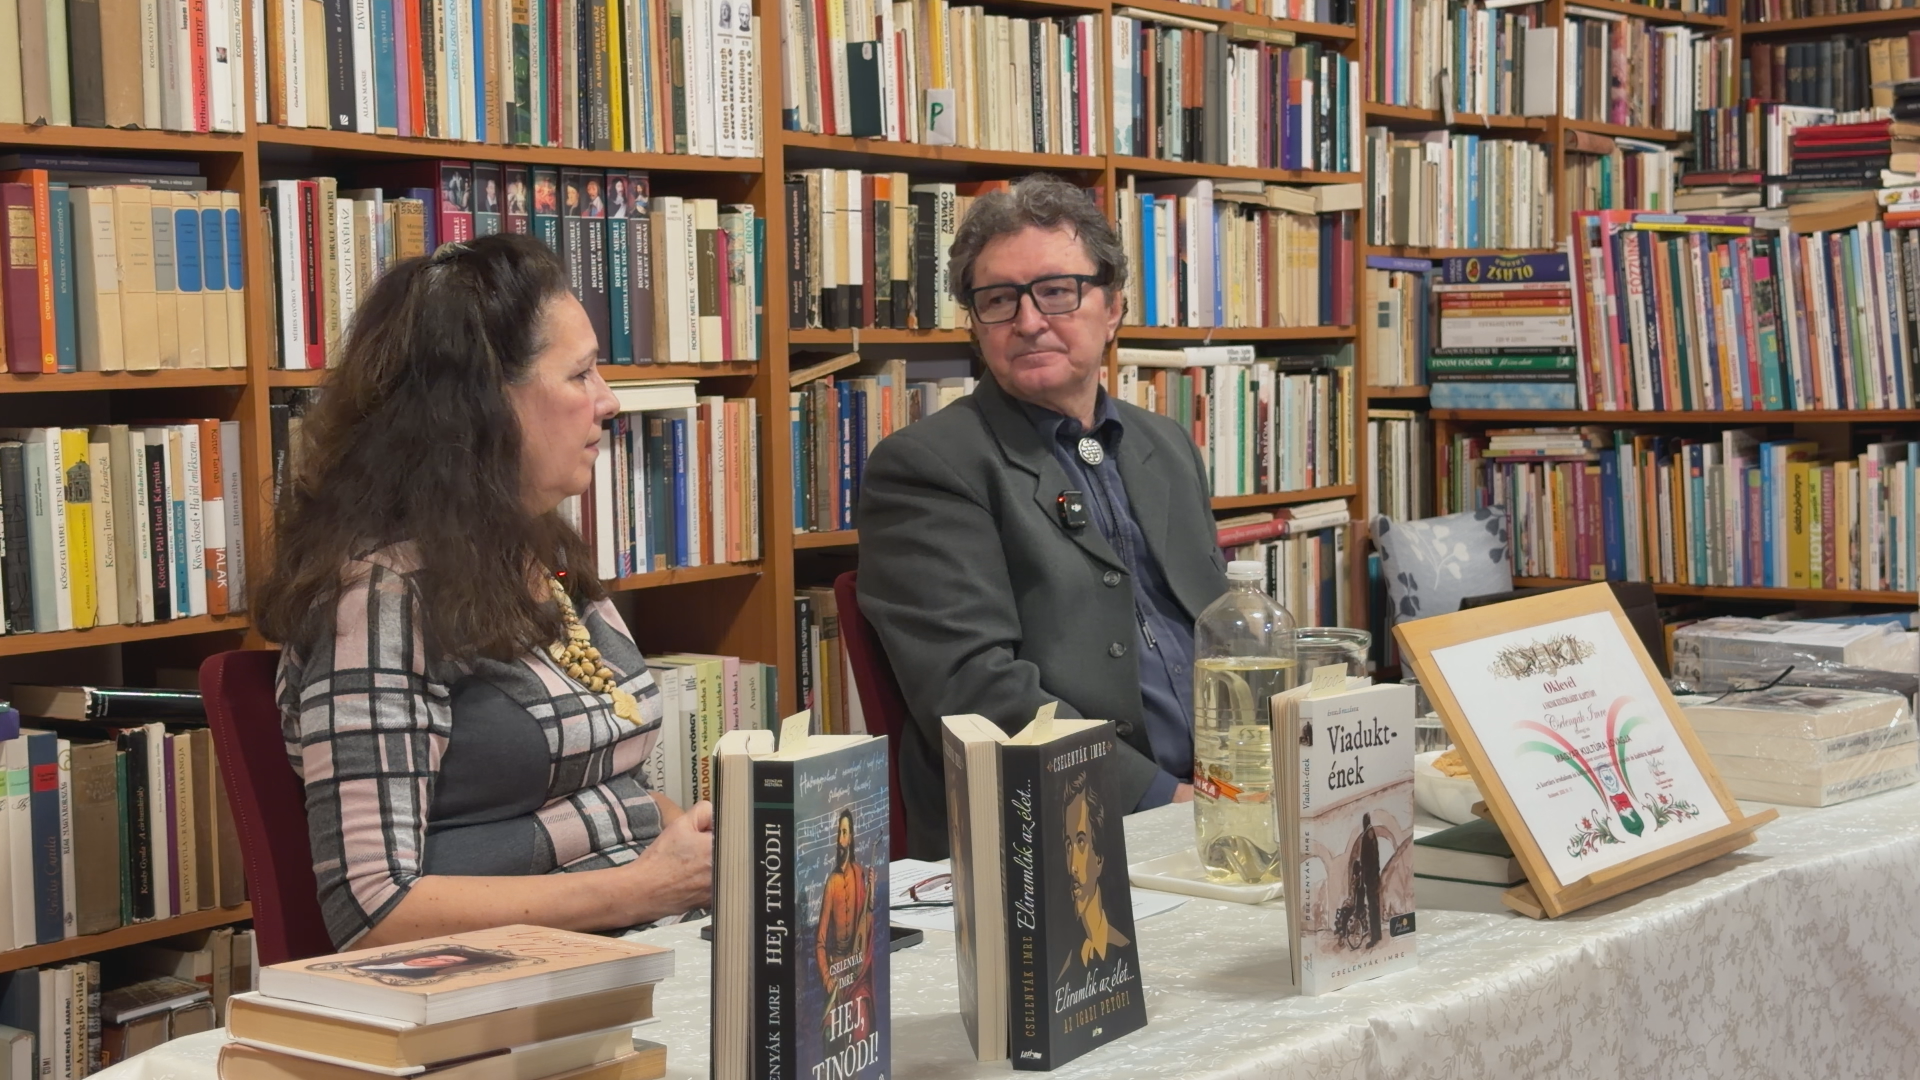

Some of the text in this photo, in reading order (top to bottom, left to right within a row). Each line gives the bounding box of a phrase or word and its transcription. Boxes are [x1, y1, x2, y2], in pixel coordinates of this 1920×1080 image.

[485, 80, 495, 128] MATULA
[596, 92, 603, 105] DU
[719, 47, 730, 140] Colleen McCullough
[738, 49, 748, 141] Colleen McCullough
[602, 102, 610, 140] MAURIER
[929, 102, 945, 132] P
[327, 228, 336, 261] HORACE
[620, 221, 628, 266] DICSŐSÉG
[635, 223, 643, 253] MERLE
[641, 223, 649, 255] RÓZSÁI
[686, 213, 694, 248] FÉRFIAK
[743, 211, 753, 255] CORONA
[792, 190, 801, 271] Erdélyi triptichon
[570, 252, 578, 288] ROBERT
[590, 253, 598, 288] ROBERT
[597, 250, 603, 262] ÉS
[612, 221, 622, 288] ROBERT MERLE
[687, 248, 695, 282] VÉDETT
[622, 266, 628, 278] ÉS
[644, 278, 650, 291] AZ
[1486, 264, 1534, 282] OLASZ
[290, 288, 298, 318] GYÖRGY
[690, 317, 698, 351] ROBERT
[1431, 358, 1494, 368] FINOM FOGÁSOK
[135, 448, 146, 507] Balkánkeringő
[188, 484, 200, 497] jól
[52, 438, 69, 591] KŐSZEGI IMRE ISTENI BEATRICE
[99, 456, 115, 569] Kőszegi Imre Farkasűzők
[190, 497, 200, 511] Ha
[152, 461, 167, 589] Köteles Pál Hotel Kárpátia
[190, 518, 202, 543] József
[192, 544, 203, 571] Köves
[699, 676, 707, 685] 3.
[715, 671, 724, 707] koldus 2.
[749, 676, 757, 711] A napló
[1542, 675, 1578, 695] Oklevél
[699, 687, 708, 712] koldus
[731, 670, 740, 731] ékozló koldus 1.
[700, 714, 709, 743] tékozló
[1326, 716, 1398, 755] Viadukt-
[689, 712, 699, 805] MOLDOVA GYÖRGY
[1053, 741, 1107, 773] CSELENYÁK IMRE
[1554, 734, 1633, 764] MAGYAR KULTÚRA LOVAGJA
[1327, 755, 1365, 791] ének
[1010, 779, 1032, 821] élet...
[138, 832, 146, 840] A
[177, 747, 192, 903] KRÚDY GYULA RÁKÓCZI HARANGJA
[1018, 820, 1036, 845] az
[1301, 758, 1312, 921] CSELENYÁK IMRE Viadukt-ének
[139, 845, 149, 870] Gyula
[759, 823, 782, 913] TINÓDI!
[140, 870, 149, 895] Krúdy
[1011, 841, 1037, 931] Eliramlik
[764, 919, 788, 966] HEJ,
[1021, 935, 1034, 966] IMRE
[829, 947, 864, 976] CSELENYÁK
[1331, 951, 1405, 979] CSELENYÁK IMRE
[75, 971, 85, 1004] világ!
[838, 972, 855, 990] IMRE
[1054, 957, 1135, 1014] Eliramlik az élet...
[76, 1004, 86, 1016] jó
[768, 984, 781, 1026] IMRE
[829, 995, 866, 1043] HEJ,
[1021, 970, 1037, 1038] CSELENYÁK
[1063, 1016, 1073, 1034] AZ
[1075, 1004, 1098, 1028] IGAZI
[1100, 990, 1131, 1017] PETŐFI
[76, 1016, 86, 1042] régi,
[76, 1051, 85, 1065] Az
[812, 1030, 880, 1080] TINÓDI!
